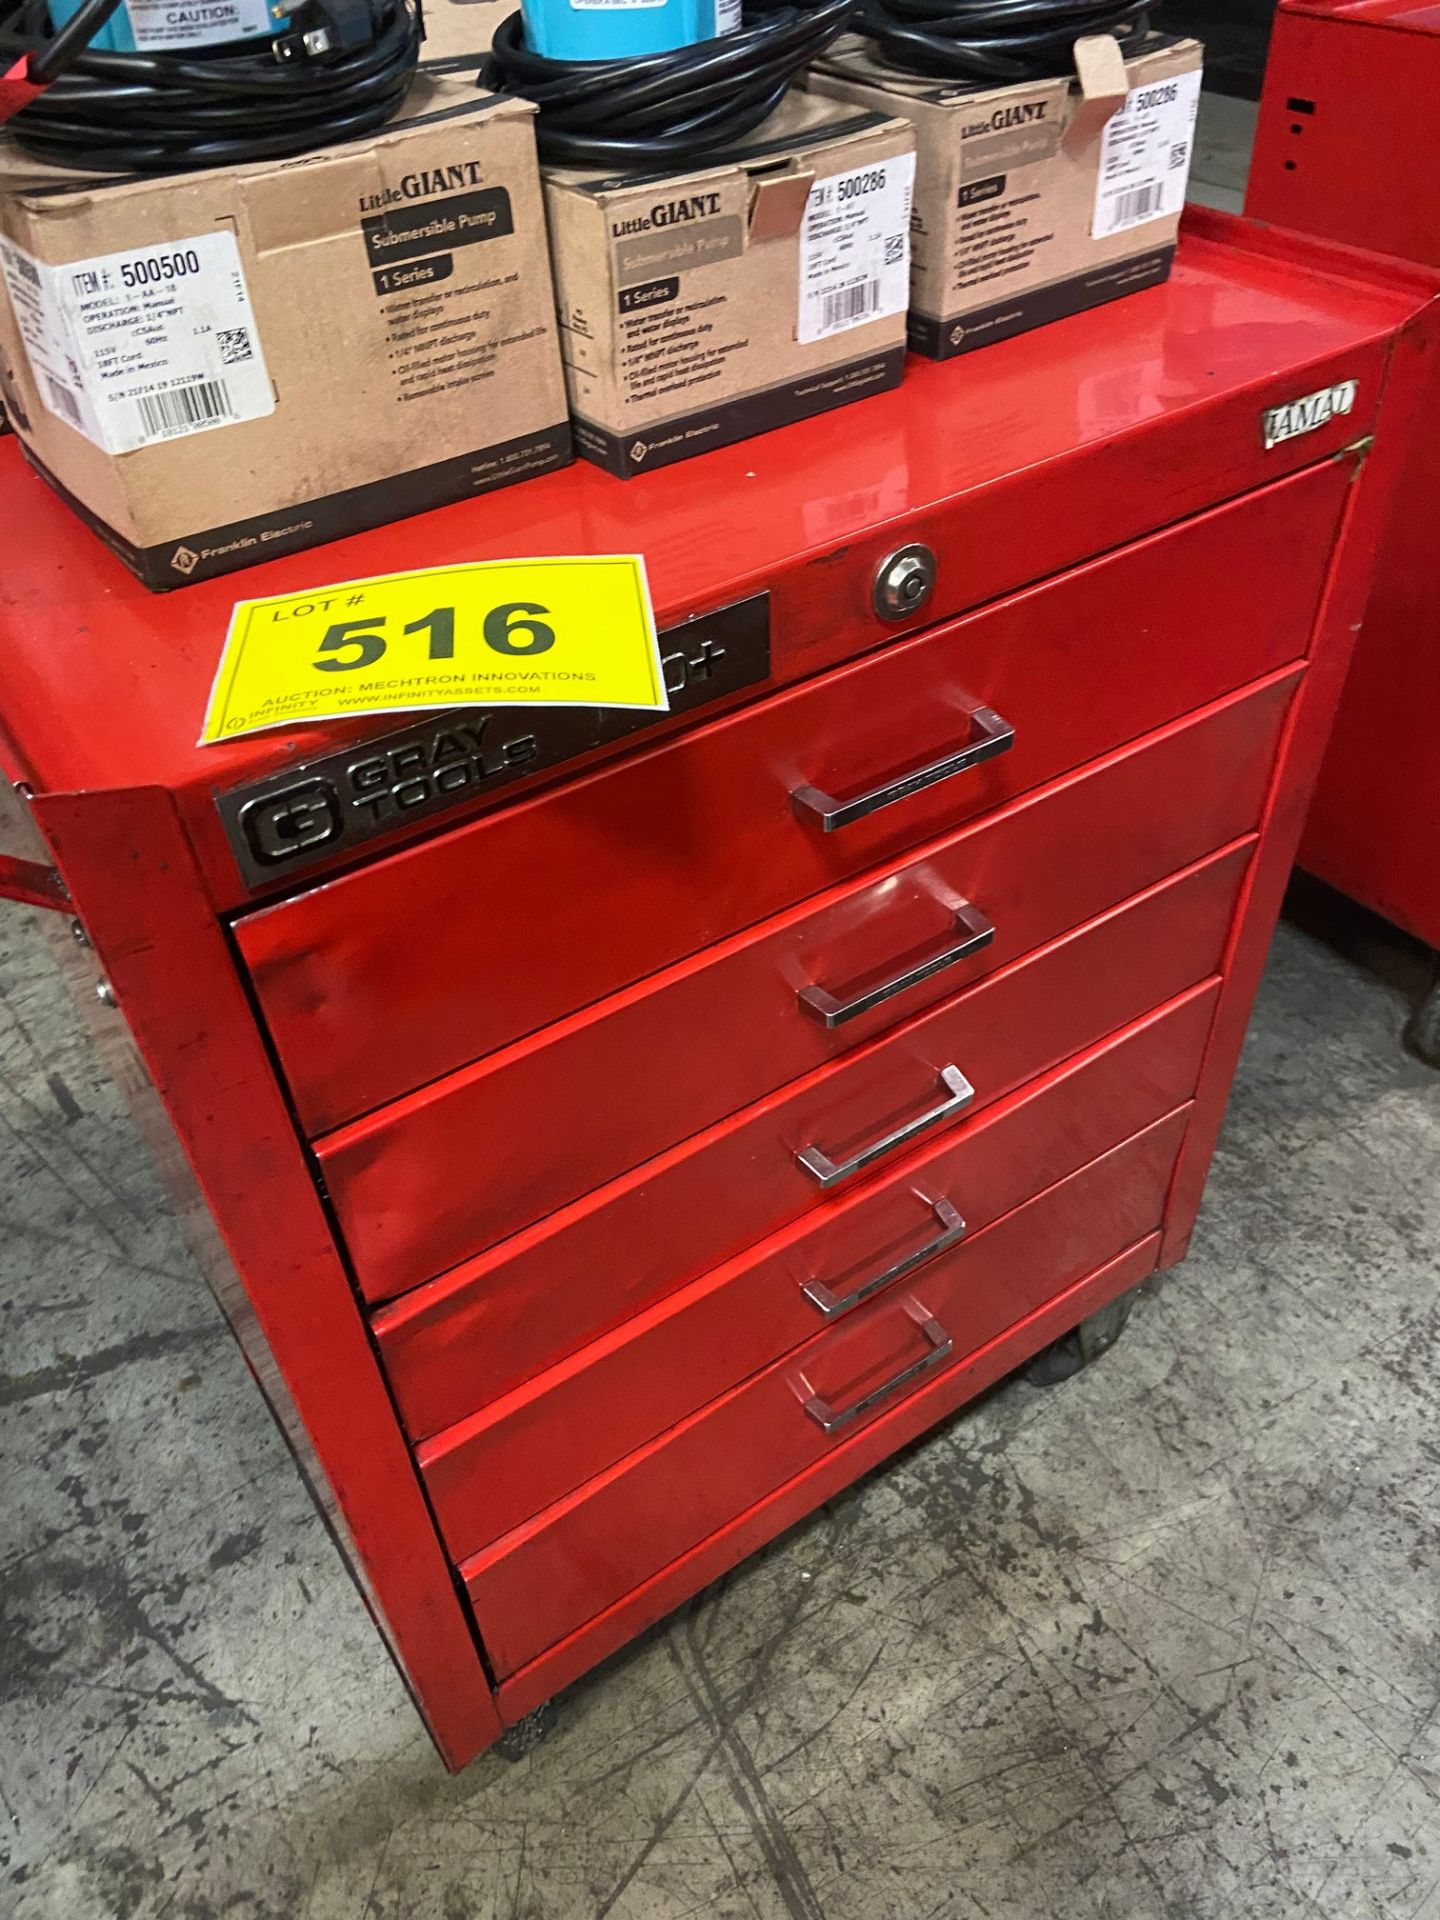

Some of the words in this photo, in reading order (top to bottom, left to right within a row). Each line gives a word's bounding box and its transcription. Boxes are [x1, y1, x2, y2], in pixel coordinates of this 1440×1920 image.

[837, 167, 886, 201] 500286
[371, 217, 456, 249] Submersible
[458, 208, 497, 231] Pump
[72, 271, 98, 296] ITEM
[120, 250, 200, 287] 500500
[381, 273, 390, 289] 1
[392, 265, 434, 285] Series
[624, 294, 631, 307] 1
[633, 285, 670, 304] Series
[259, 520, 314, 542] Electric
[271, 598, 341, 622] LOT
[346, 593, 366, 607] #
[312, 601, 556, 673] 516
[263, 684, 353, 708] AUCTION:
[358, 673, 467, 693] MECHTRON
[471, 671, 598, 682] INNOVATIONS
[337, 684, 541, 707] WWW.INFINITYASSETS.COM
[248, 698, 319, 721] INFINITY
[346, 714, 493, 793] GRAY
[352, 735, 538, 830] TOOLS
